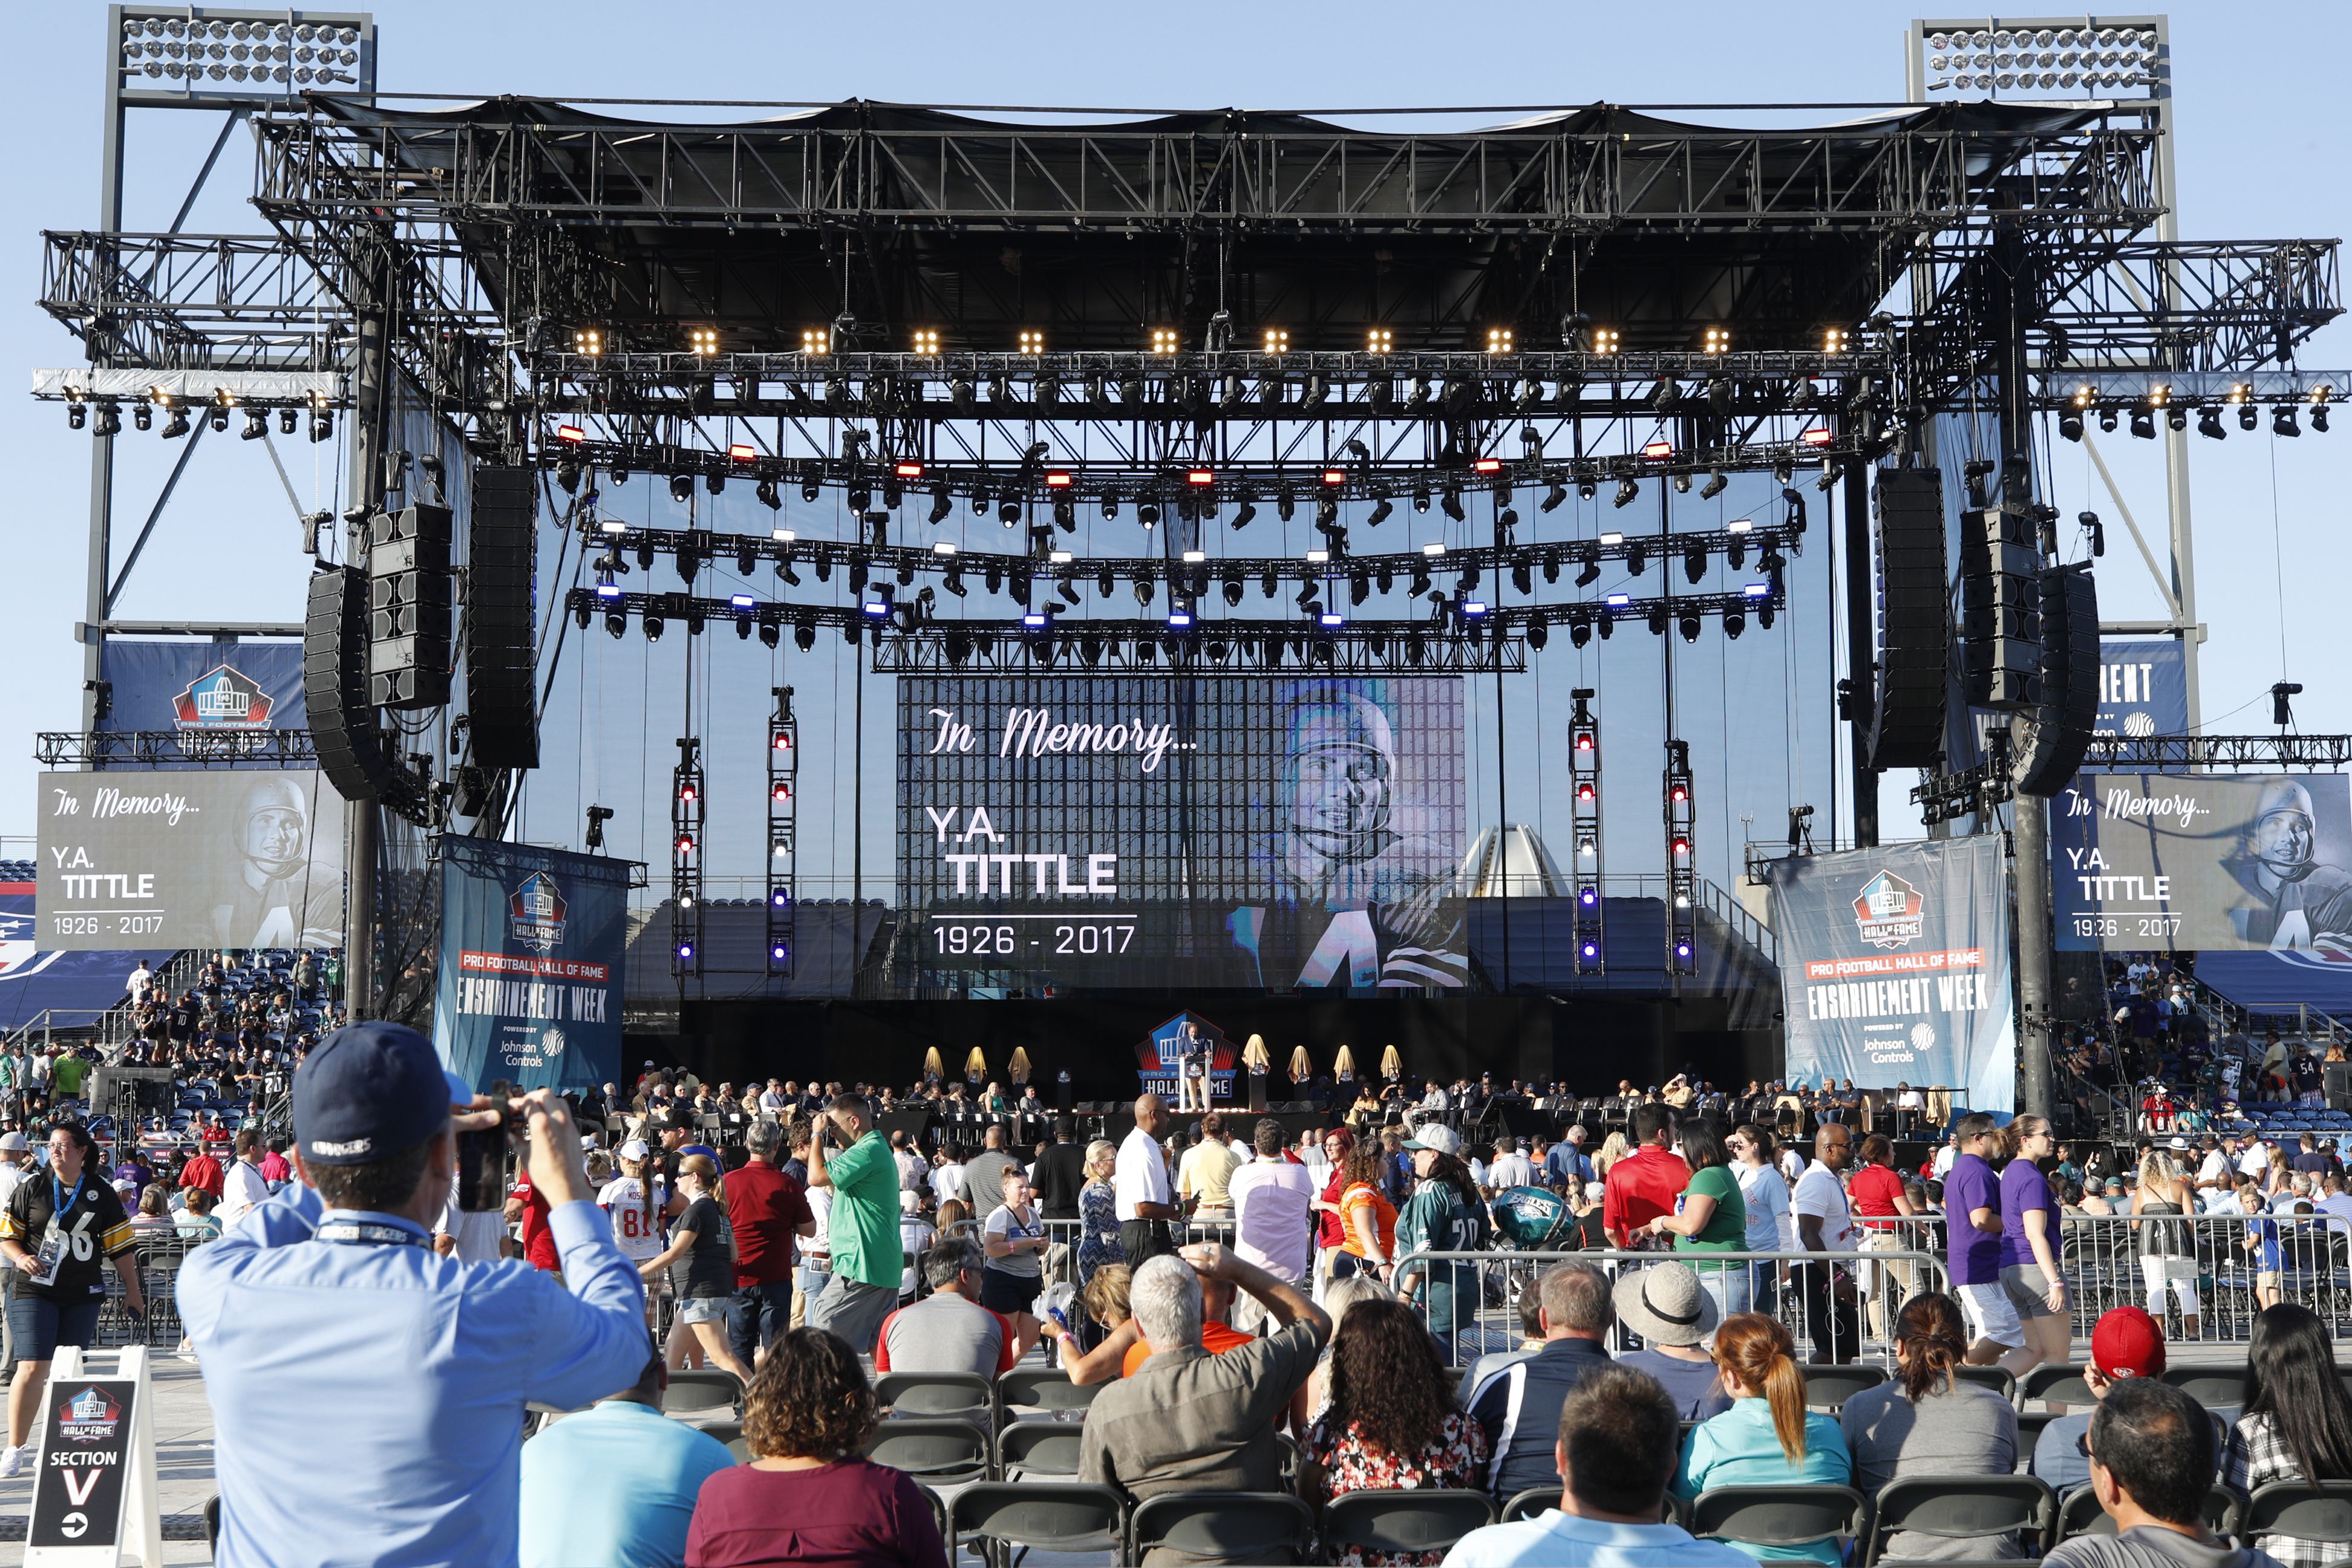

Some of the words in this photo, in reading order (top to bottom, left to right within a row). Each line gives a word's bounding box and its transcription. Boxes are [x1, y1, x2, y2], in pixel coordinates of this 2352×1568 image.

[928, 708, 976, 754] In
[1000, 707, 1198, 774] Memory...
[53, 788, 80, 816] In
[92, 786, 200, 826] Memory...
[2065, 788, 2092, 817] In
[2105, 788, 2210, 828] Memory...
[925, 806, 1005, 843] Y.A.
[51, 846, 94, 869] Y.A.
[2066, 847, 2110, 870] Y.A.
[945, 854, 1117, 894] TITTLE
[60, 874, 155, 899] TITTLE
[2077, 875, 2171, 901] TITTLE
[53, 917, 98, 935] 1926
[119, 916, 163, 934] 2017
[515, 924, 536, 938] HALL
[540, 927, 561, 939] FAME
[1863, 925, 1887, 938] HALL
[1893, 922, 1919, 935] FAME
[2073, 919, 2117, 937] 1926
[2138, 919, 2181, 936] 2017
[933, 926, 1014, 954] 1926
[1055, 925, 1135, 954] 2017
[463, 954, 484, 968] PRO
[486, 956, 535, 972] FOOTBALL
[538, 961, 564, 975] HALL
[566, 964, 578, 976] OF
[581, 965, 604, 978] FAME
[1811, 964, 1834, 976] PRO
[1836, 959, 1893, 974] FOOTBALL
[1895, 955, 1927, 970] HALL
[1930, 953, 1945, 967] OF
[1947, 951, 1980, 967] FAME
[456, 976, 566, 1020] ENSHRINEMENT
[571, 985, 607, 1023] WEEK
[1807, 977, 1930, 1021] ENSHRINEMENT
[1937, 973, 1989, 1013] WEEK
[177, 1014, 187, 1026] 10
[499, 1040, 537, 1053] Johnson
[1870, 1050, 1915, 1064] Controls
[505, 1054, 543, 1067] Controls
[2299, 1060, 2315, 1076] 54
[1145, 1079, 1180, 1094] HALL
[1507, 1191, 1560, 1217] EAGLES
[623, 1209, 651, 1238] 81
[62, 1425, 85, 1436] HALL
[90, 1425, 113, 1435] FAME
[50, 1451, 118, 1466] SECTION
[62, 1468, 103, 1506] V
